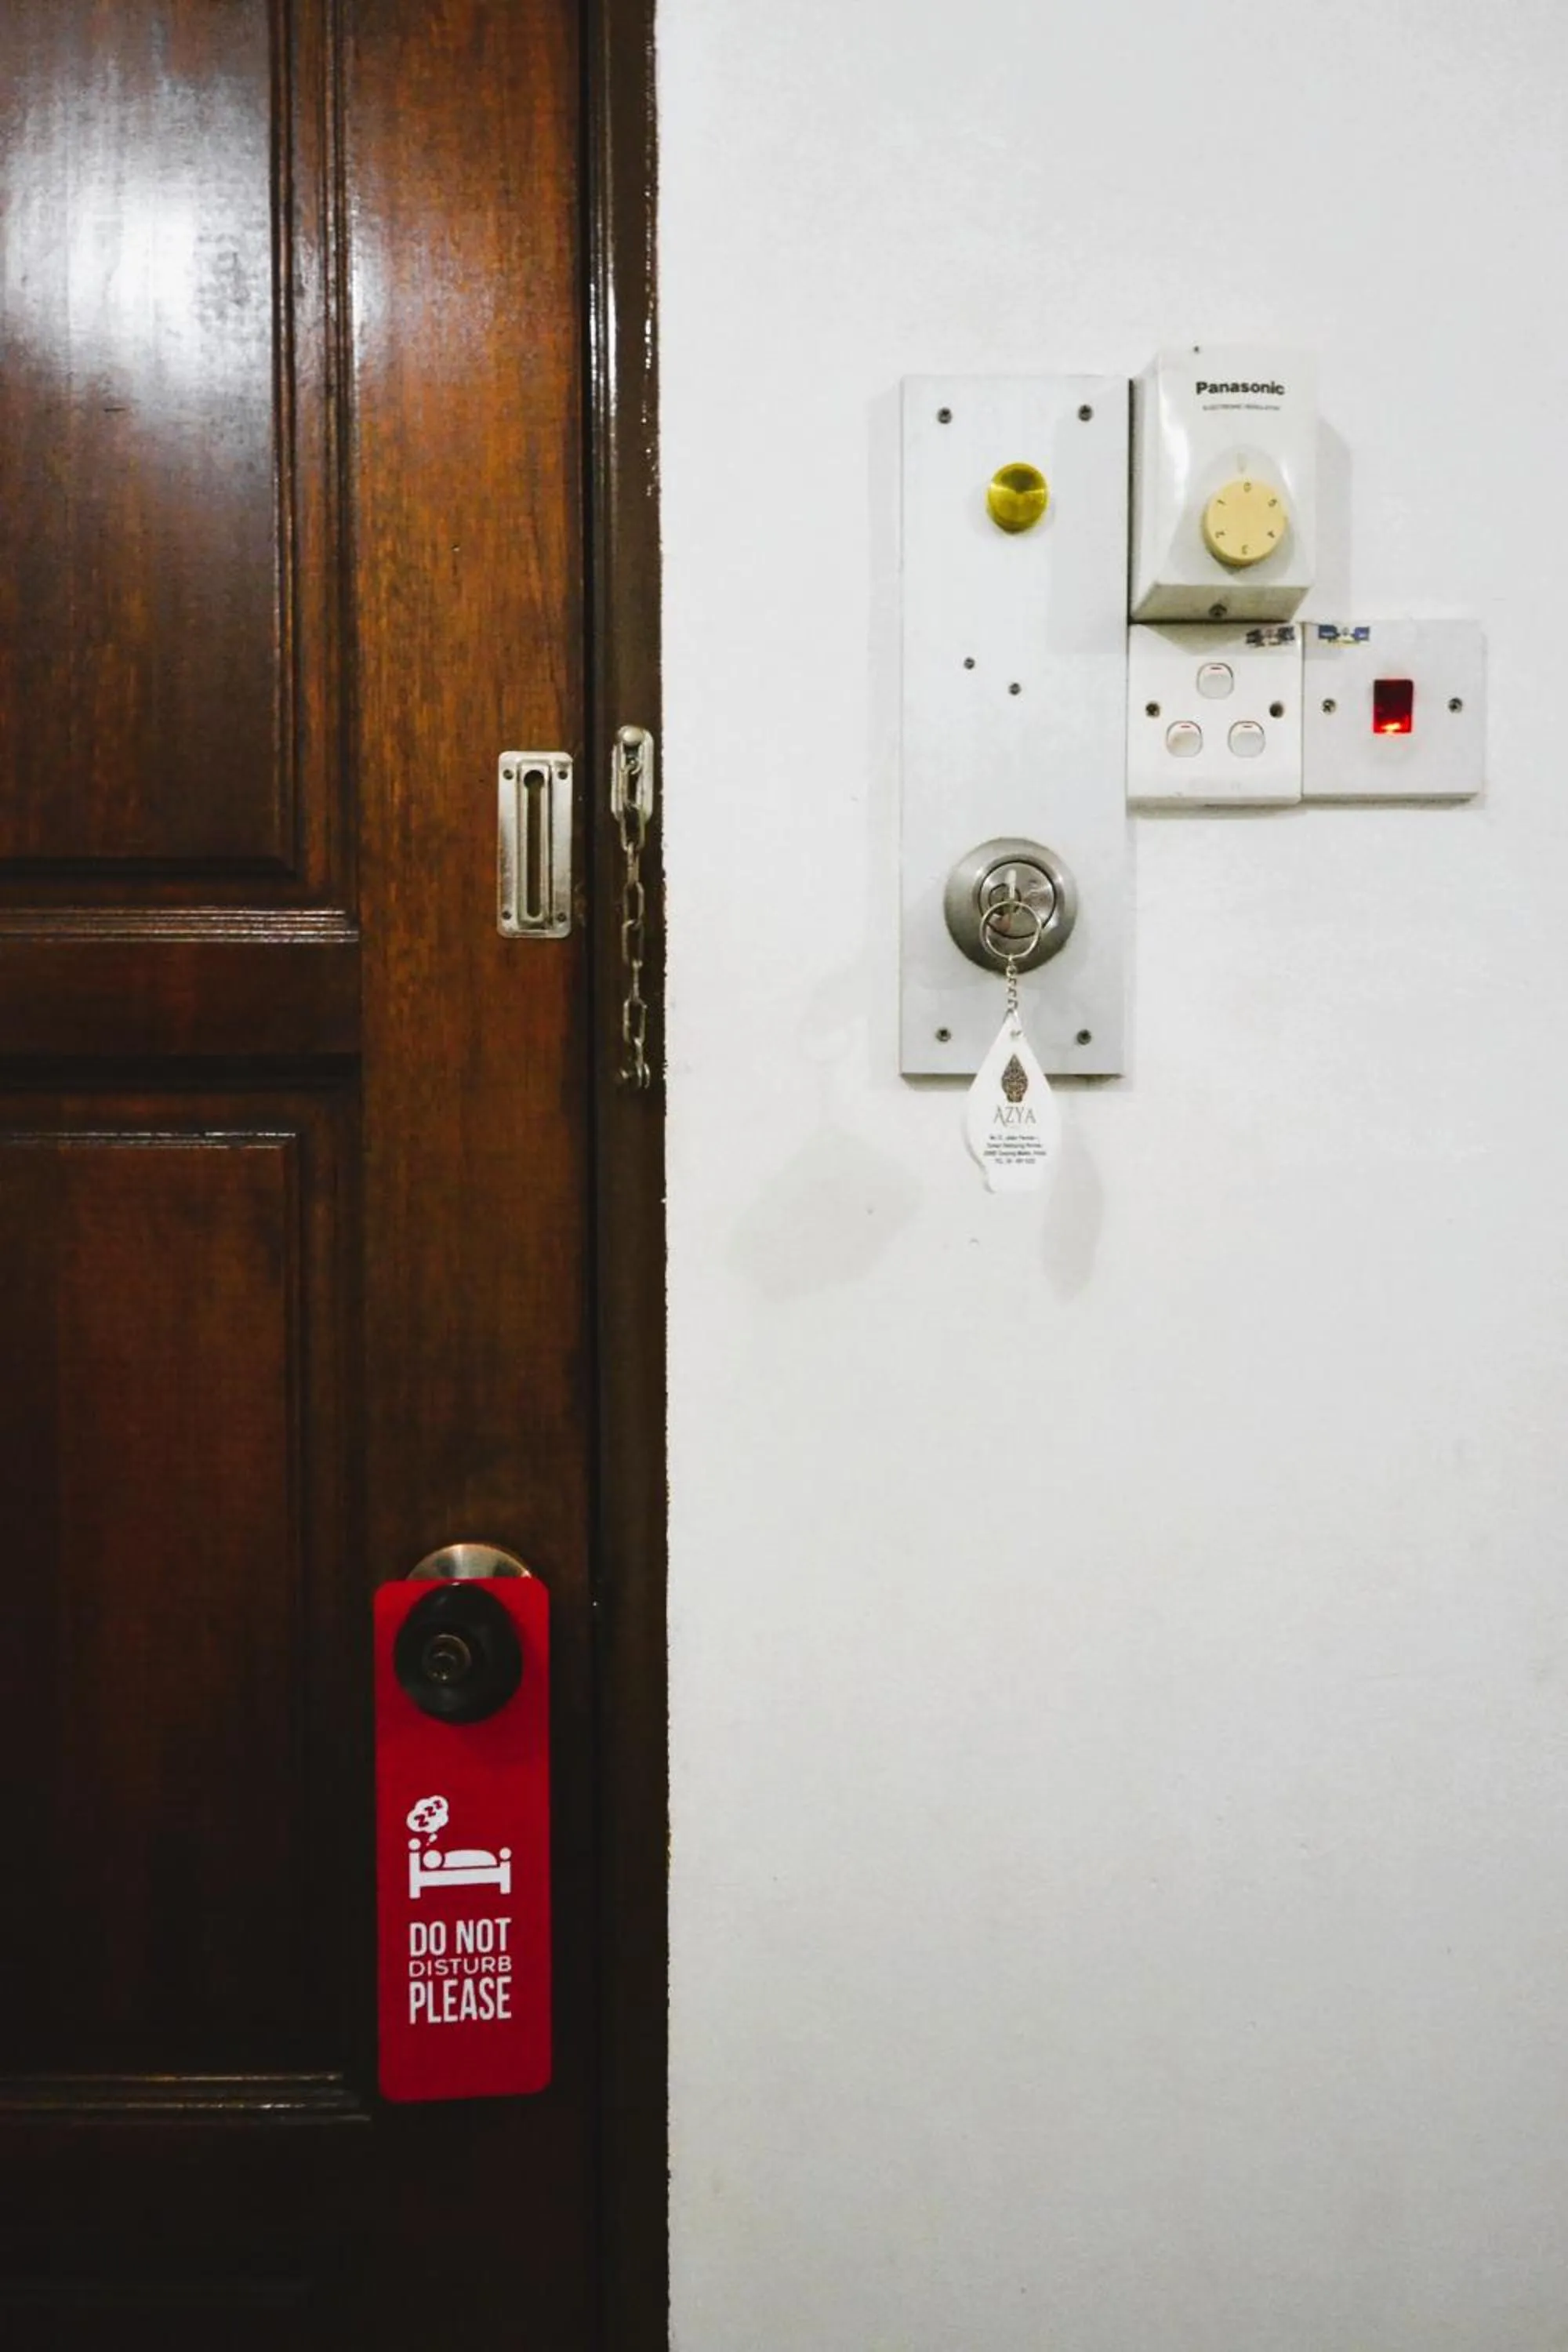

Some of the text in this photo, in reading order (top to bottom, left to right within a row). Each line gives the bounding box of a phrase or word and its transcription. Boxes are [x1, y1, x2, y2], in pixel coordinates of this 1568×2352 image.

[1196, 381, 1286, 395] Panasonic
[993, 1105, 1036, 1126] AZYA
[408, 1918, 512, 1957] DO NOT
[408, 1956, 512, 1977] DISTURB
[408, 1975, 512, 2024] PLEASE
